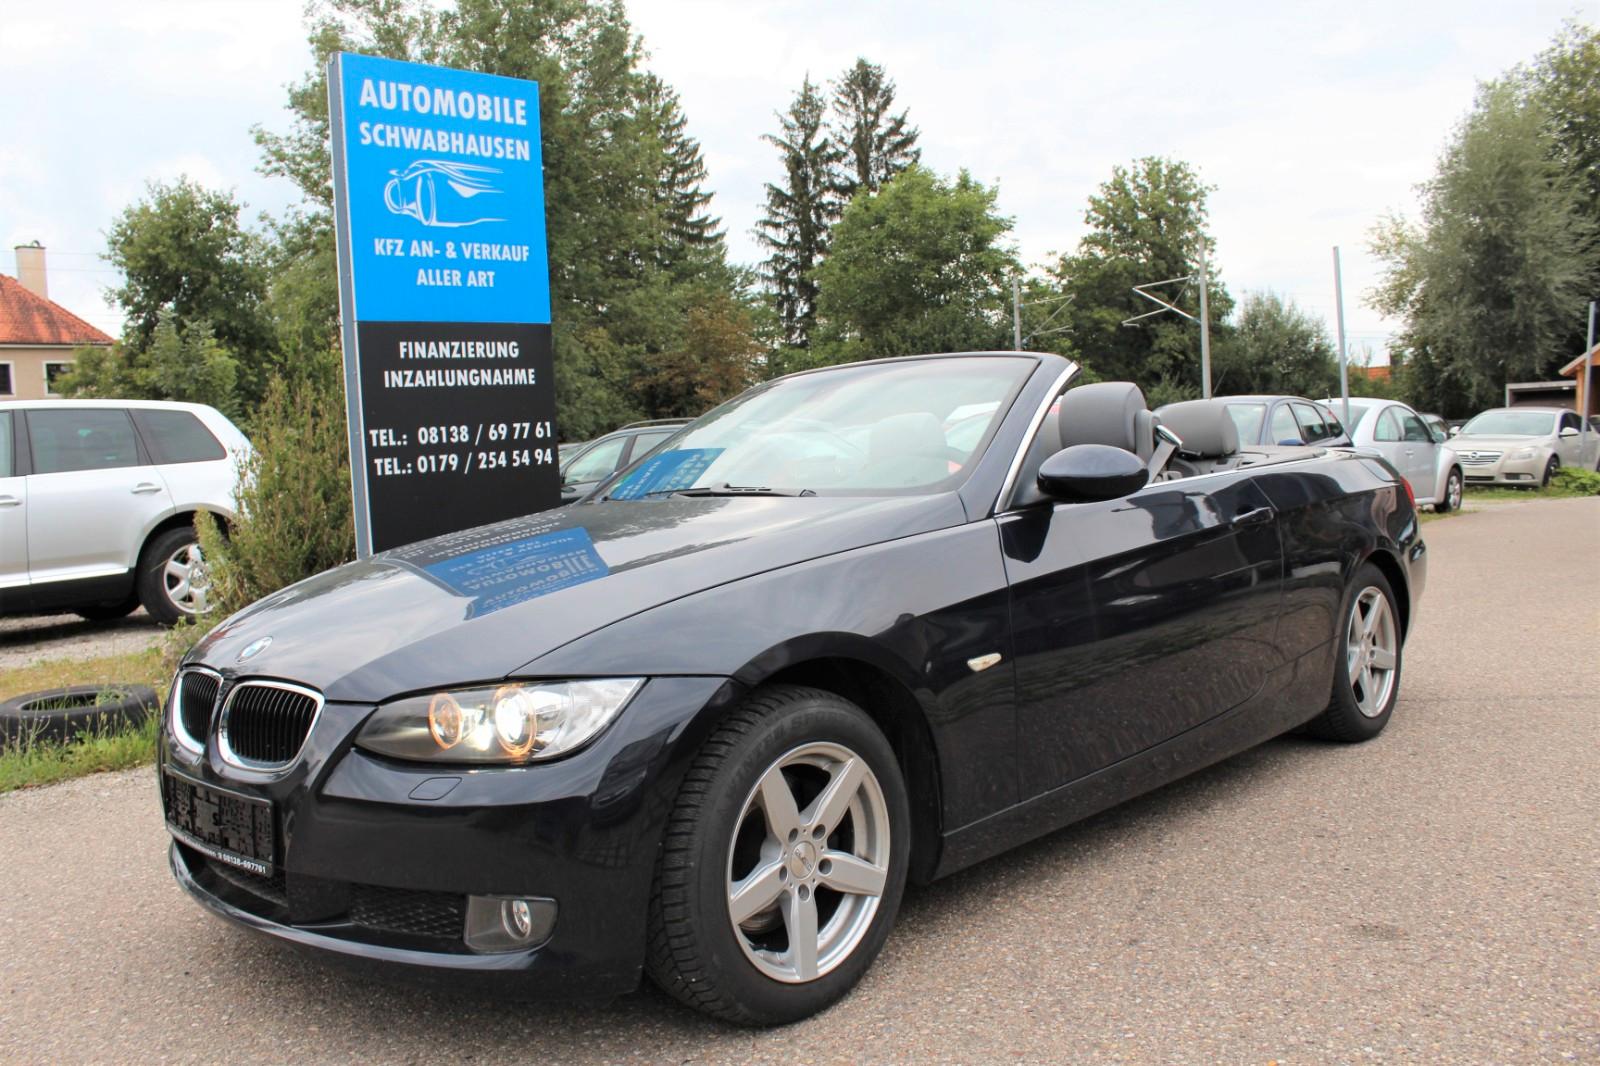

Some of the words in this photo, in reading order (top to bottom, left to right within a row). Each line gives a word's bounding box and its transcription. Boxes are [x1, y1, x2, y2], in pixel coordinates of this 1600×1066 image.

[359, 79, 527, 126] AUTOMOBILE
[359, 121, 530, 161] SCHWABHAUSEN
[374, 238, 404, 257] KFZ
[410, 240, 440, 257] AN-
[445, 241, 457, 259] &
[461, 242, 529, 262] VERKAUF
[416, 268, 462, 287] ALLER
[467, 271, 495, 287] ART
[399, 341, 520, 359] FINANZIERUNG
[384, 368, 536, 388] INZAHLUNGNAHME
[369, 428, 408, 447] TEL.:
[417, 425, 469, 445] 08138
[475, 423, 483, 446] /
[488, 423, 507, 441] 69
[512, 422, 531, 440] 77
[535, 421, 552, 438] 61
[374, 458, 412, 476] TEL.:
[417, 454, 459, 474] 0179
[464, 452, 472, 475] /
[478, 451, 507, 470] 254
[512, 449, 530, 467] 54
[535, 448, 553, 465] 94
